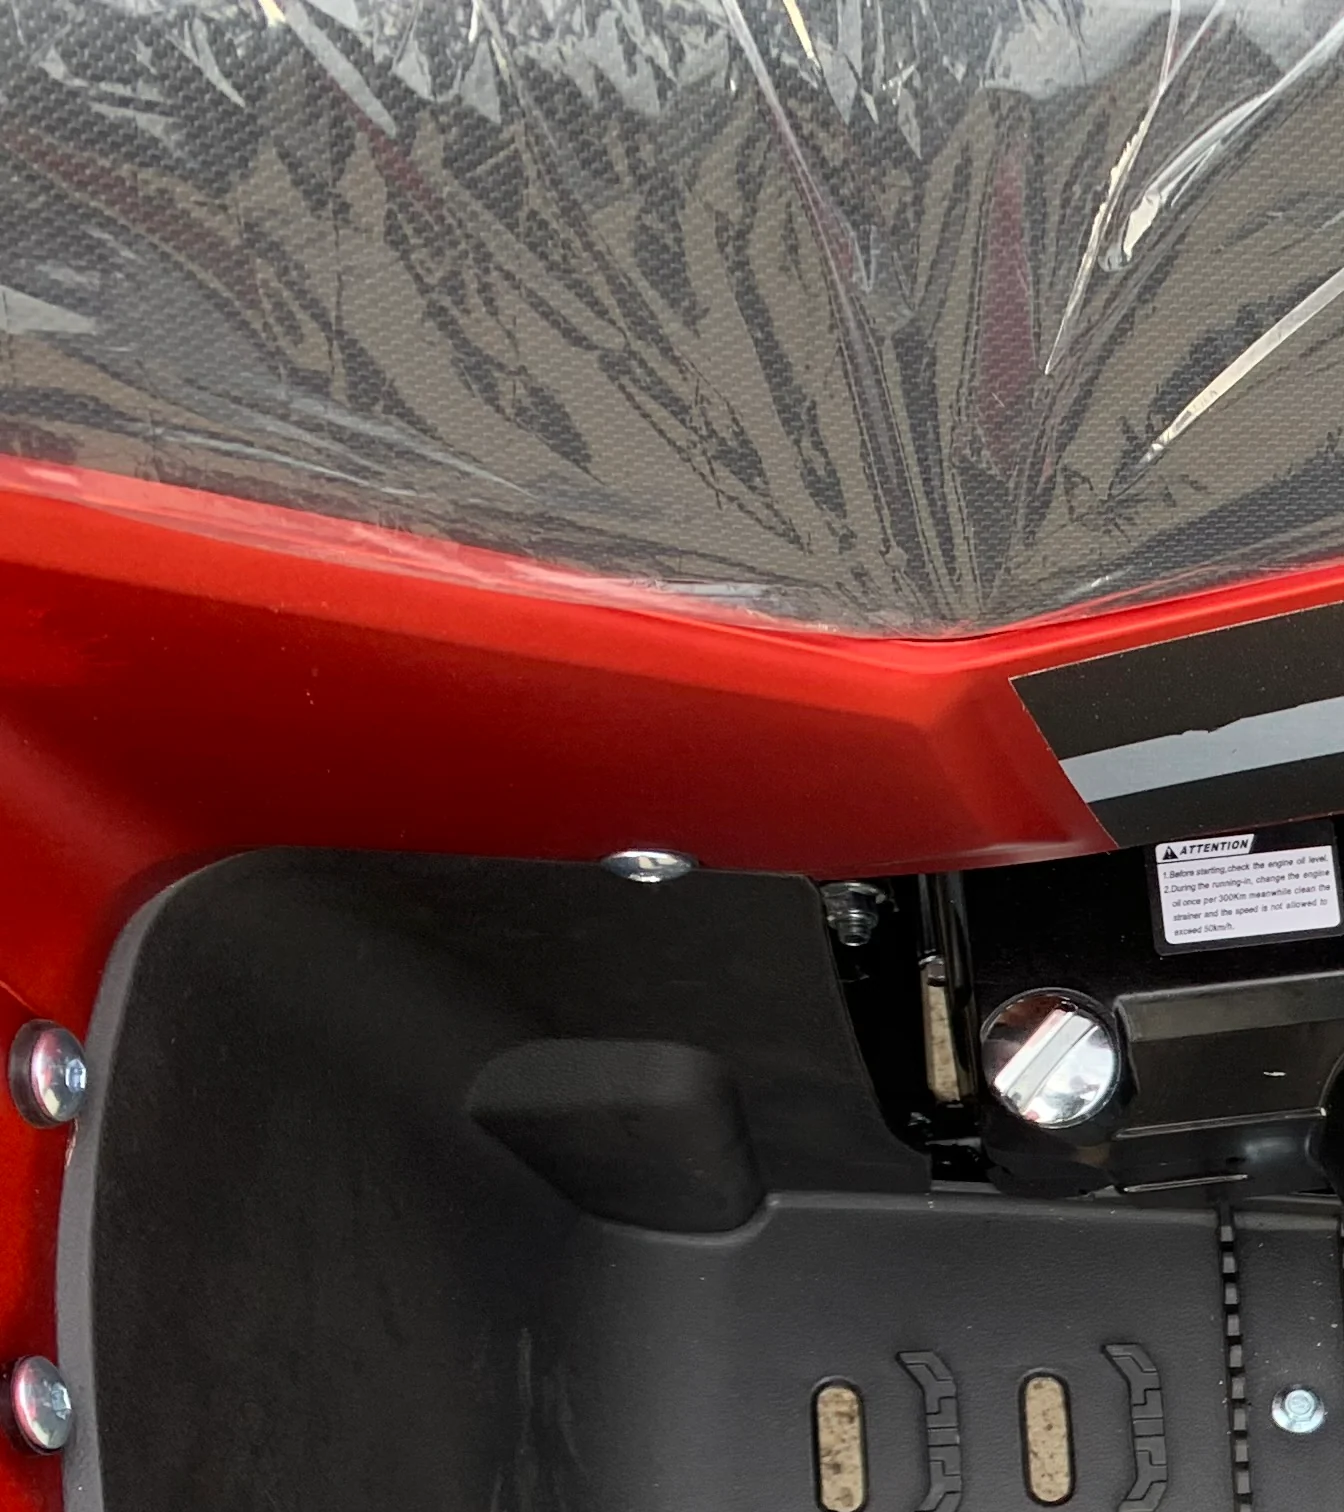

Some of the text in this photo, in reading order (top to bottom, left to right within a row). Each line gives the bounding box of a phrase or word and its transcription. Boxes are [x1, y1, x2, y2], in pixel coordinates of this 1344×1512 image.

[1179, 839, 1250, 856] ATTENTION
[1253, 862, 1265, 870] the
[1267, 859, 1294, 869] engine
[1296, 856, 1306, 865] oil
[1197, 882, 1210, 890] the
[1255, 874, 1286, 884] change
[1287, 872, 1300, 880] the
[1302, 869, 1330, 879] engine
[1171, 899, 1182, 908] oil
[1182, 898, 1202, 907] once
[1203, 896, 1218, 906] per
[1248, 887, 1292, 899] meanwhile
[1294, 885, 1316, 895] clean
[1318, 884, 1331, 892] the
[1173, 912, 1202, 922] strainer
[1203, 909, 1219, 918] and
[1220, 908, 1233, 917] the
[1235, 905, 1259, 916] speed
[1270, 902, 1283, 911] not
[1285, 898, 1317, 910] allowed
[1319, 898, 1328, 906] to
[1174, 926, 1202, 937] exceed
